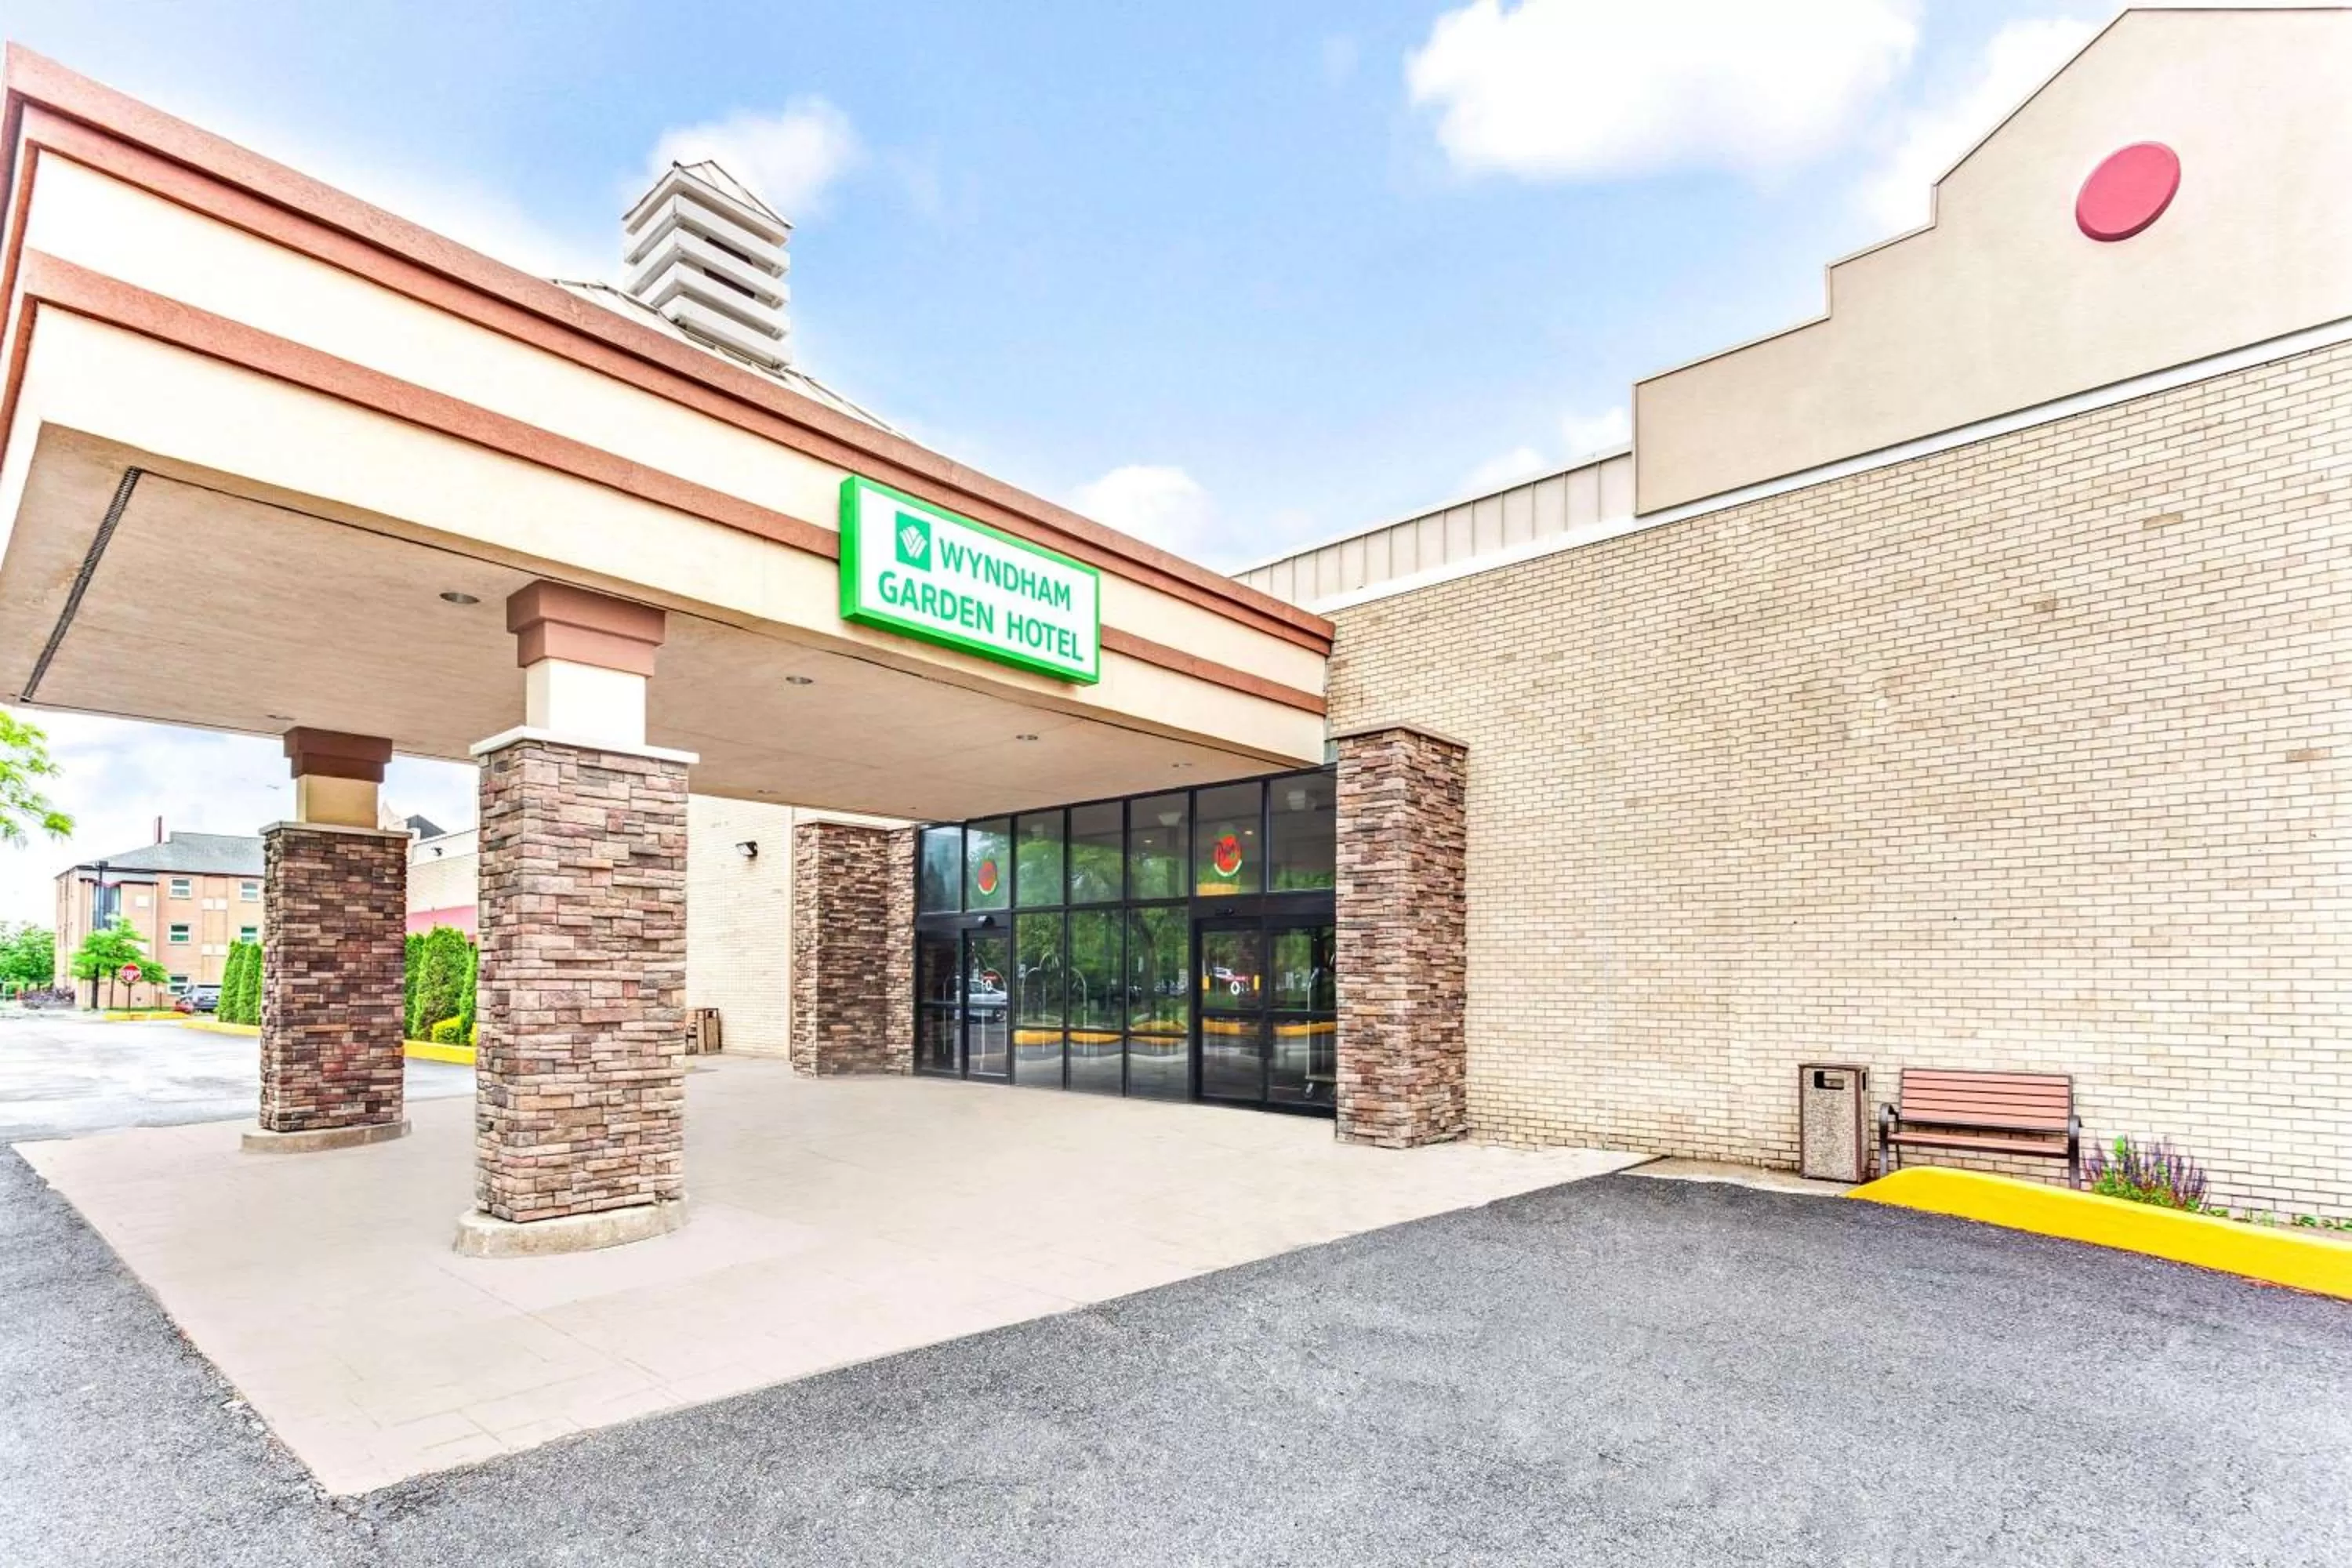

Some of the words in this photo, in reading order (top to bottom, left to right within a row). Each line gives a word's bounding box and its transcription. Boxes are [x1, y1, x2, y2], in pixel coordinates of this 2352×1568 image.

[939, 537, 1071, 612] WYNDHAM
[878, 571, 994, 634] GARDEN
[1007, 611, 1083, 662] HOTEL
